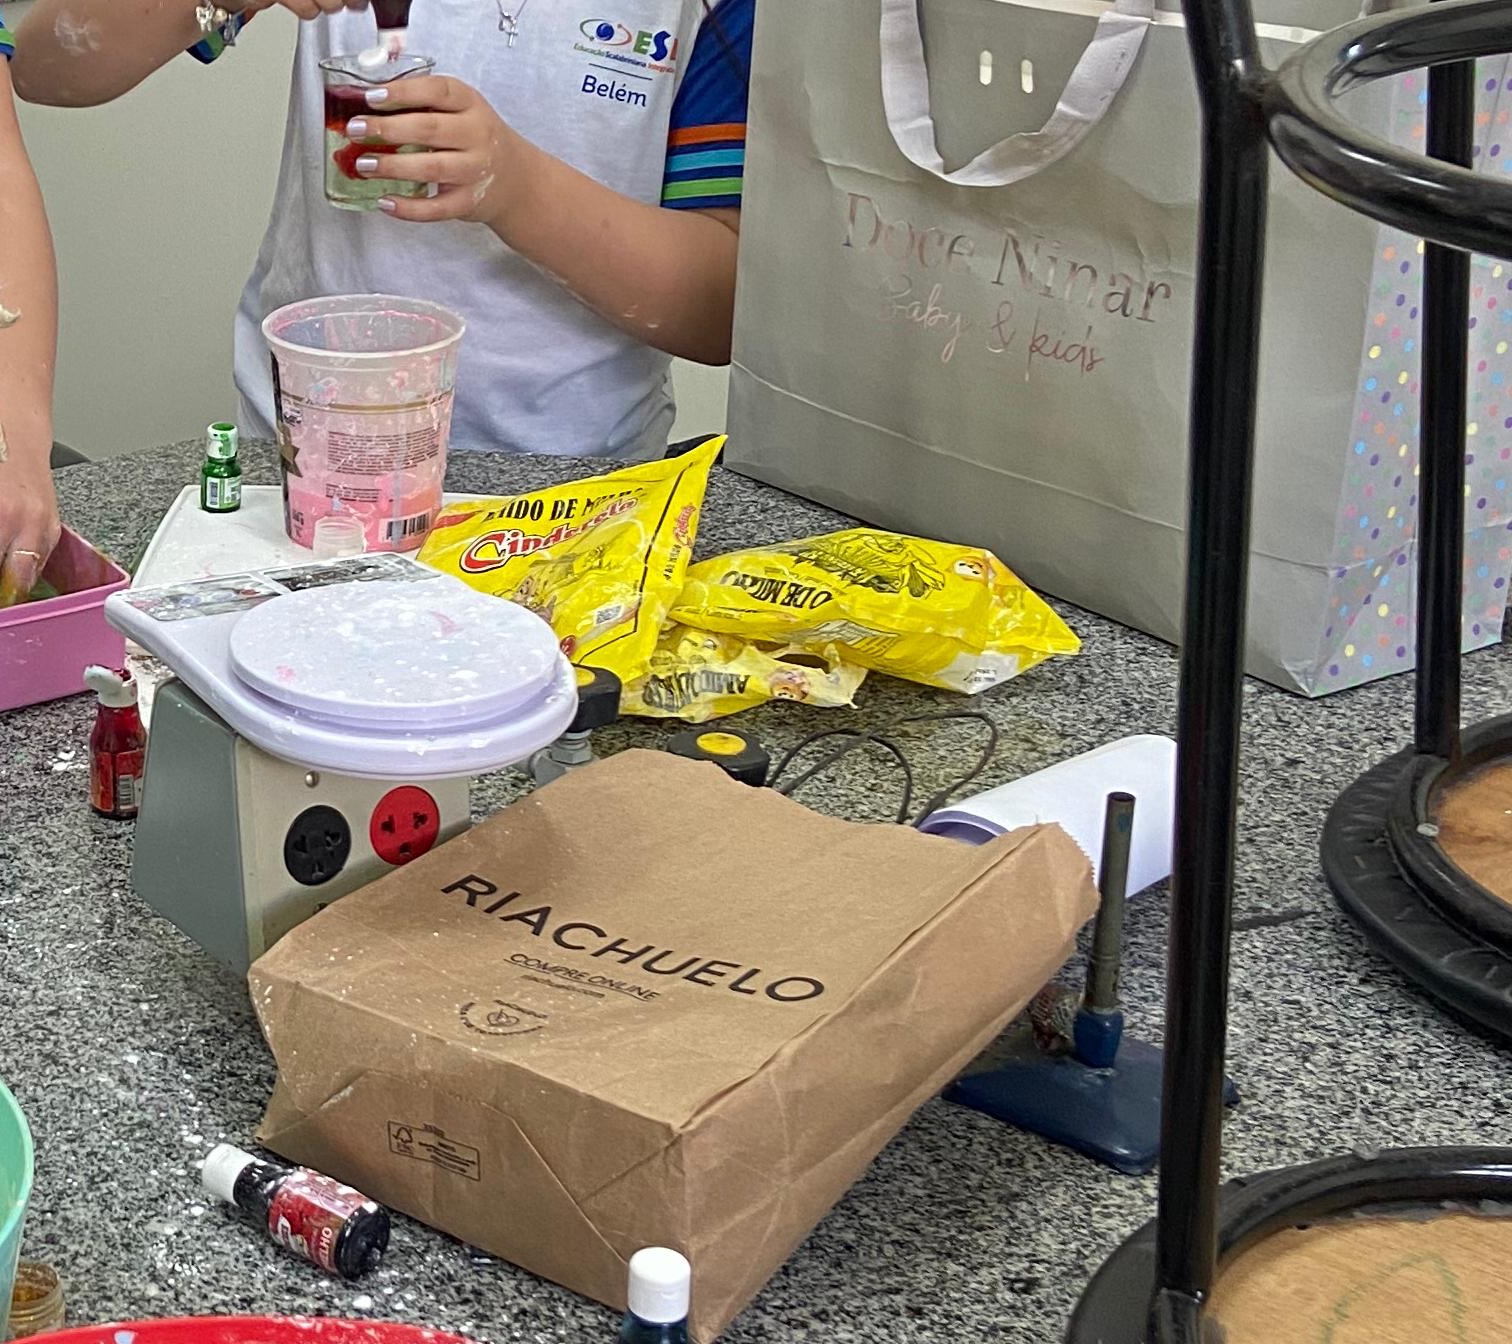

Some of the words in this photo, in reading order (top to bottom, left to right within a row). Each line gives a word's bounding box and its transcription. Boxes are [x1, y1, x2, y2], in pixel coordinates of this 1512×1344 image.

[632, 30, 679, 62] ESI
[581, 74, 647, 107] Belém
[990, 228, 1173, 323] Ninar
[550, 498, 578, 521] DE
[440, 873, 825, 1003] RIACHUELO
[509, 953, 590, 984] COMPRE
[587, 973, 660, 1001] ONLINE
